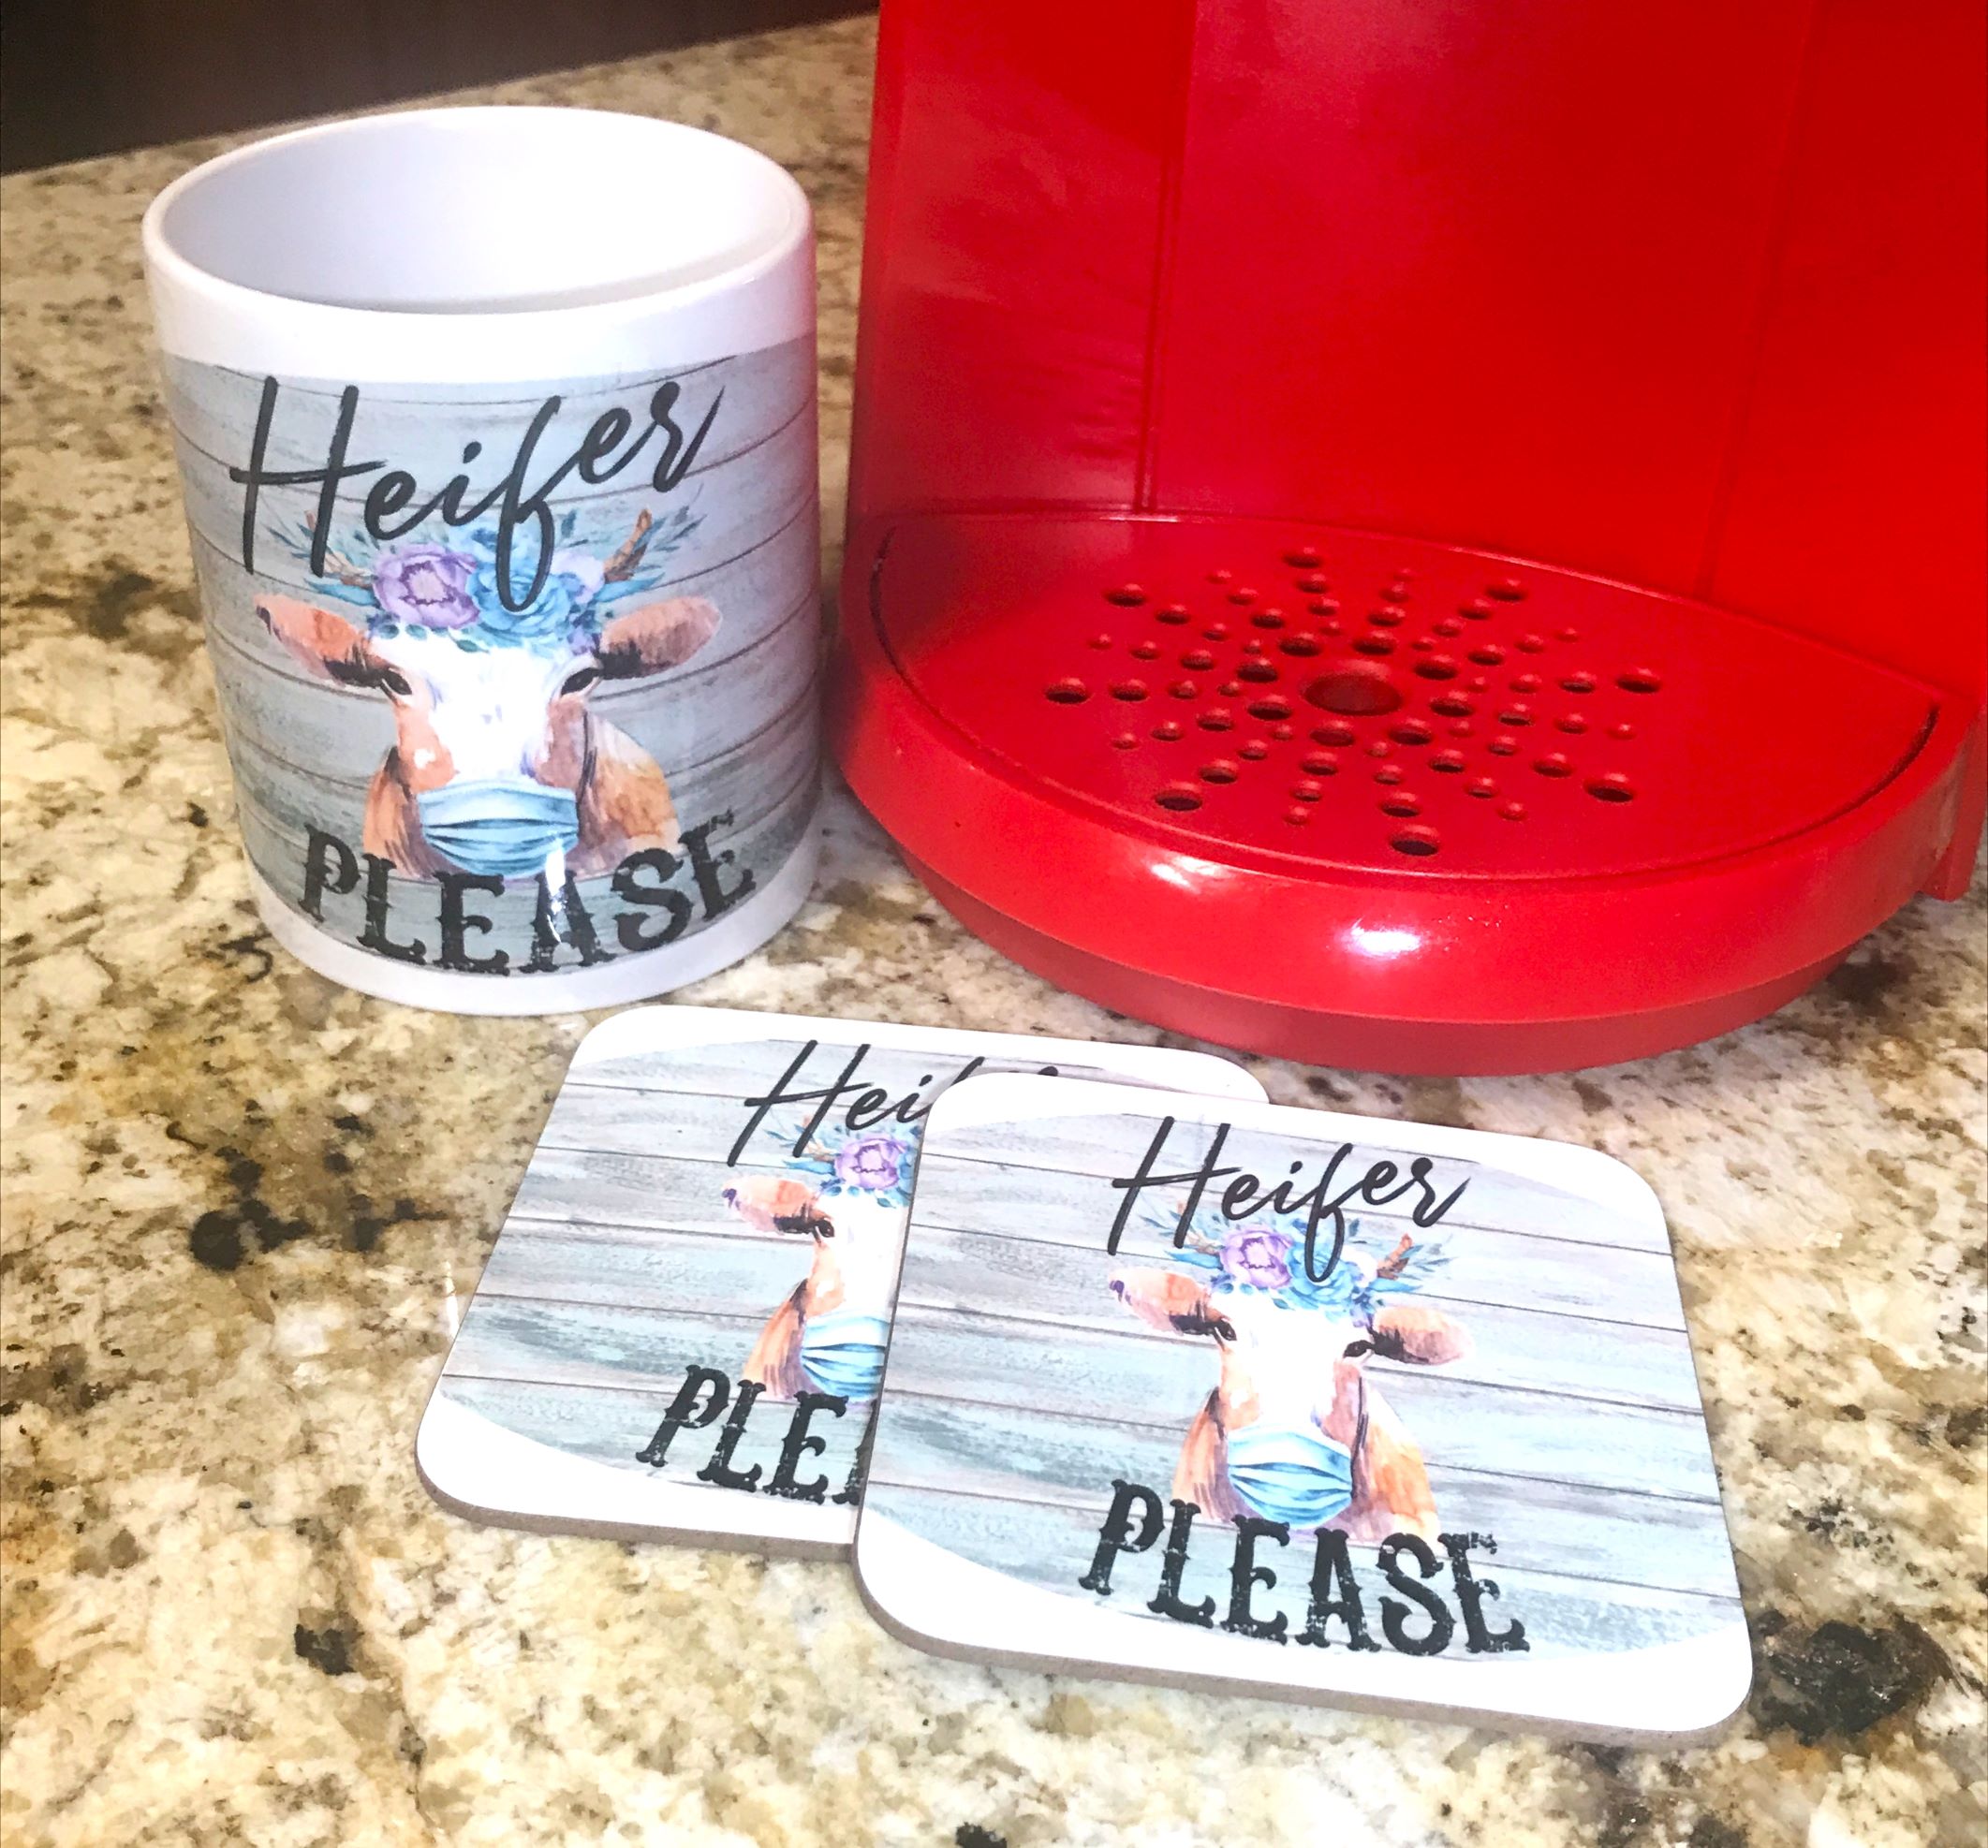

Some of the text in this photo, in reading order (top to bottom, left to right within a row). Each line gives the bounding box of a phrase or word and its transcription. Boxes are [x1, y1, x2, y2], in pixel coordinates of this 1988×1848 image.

[229, 375, 725, 611] Heifer
[298, 809, 756, 975] PLEASE
[1107, 1116, 1470, 1283] Heifer
[1078, 1478, 1530, 1656] PLEASE
